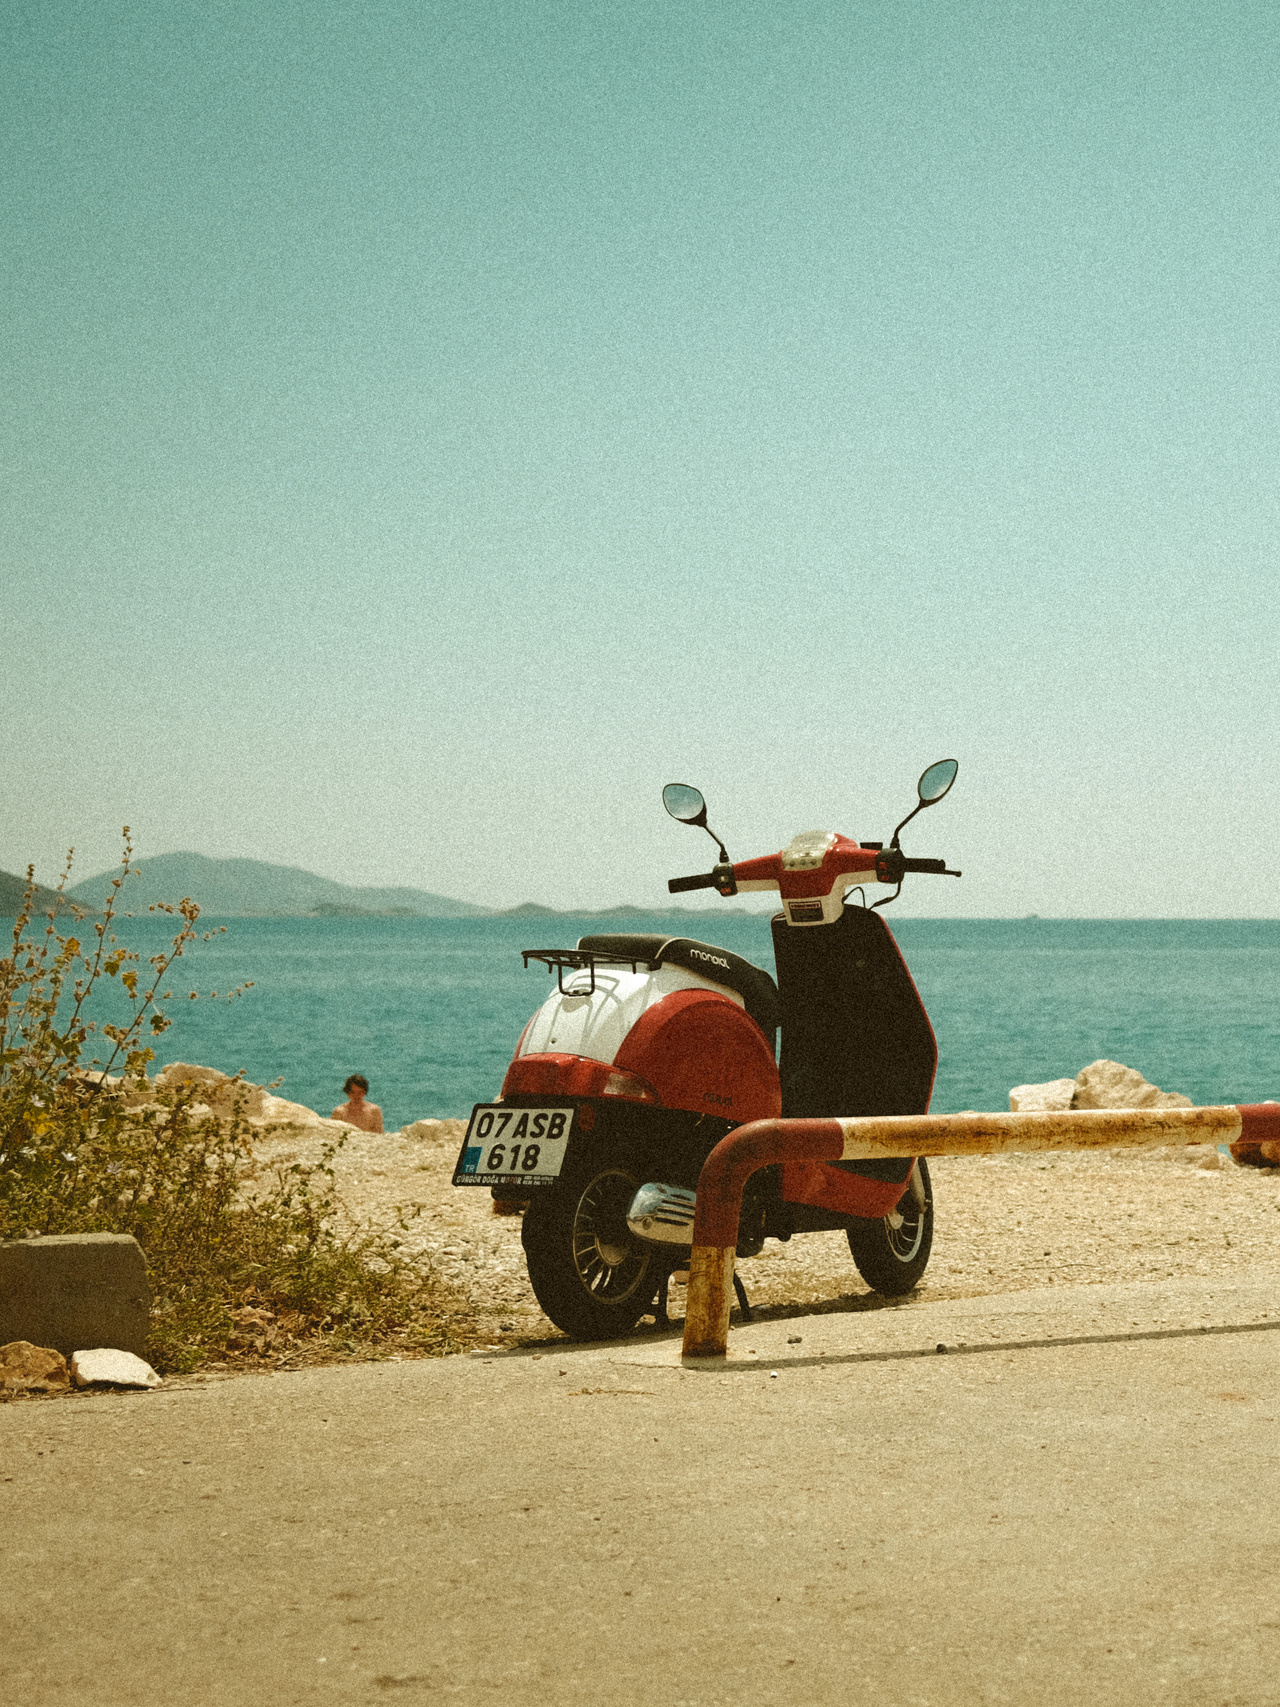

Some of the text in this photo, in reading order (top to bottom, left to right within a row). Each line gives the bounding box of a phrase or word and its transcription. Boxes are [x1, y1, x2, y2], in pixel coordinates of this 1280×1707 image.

[690, 949, 731, 969] mondial
[487, 1143, 541, 1171] 618
[465, 1164, 475, 1173] TR
